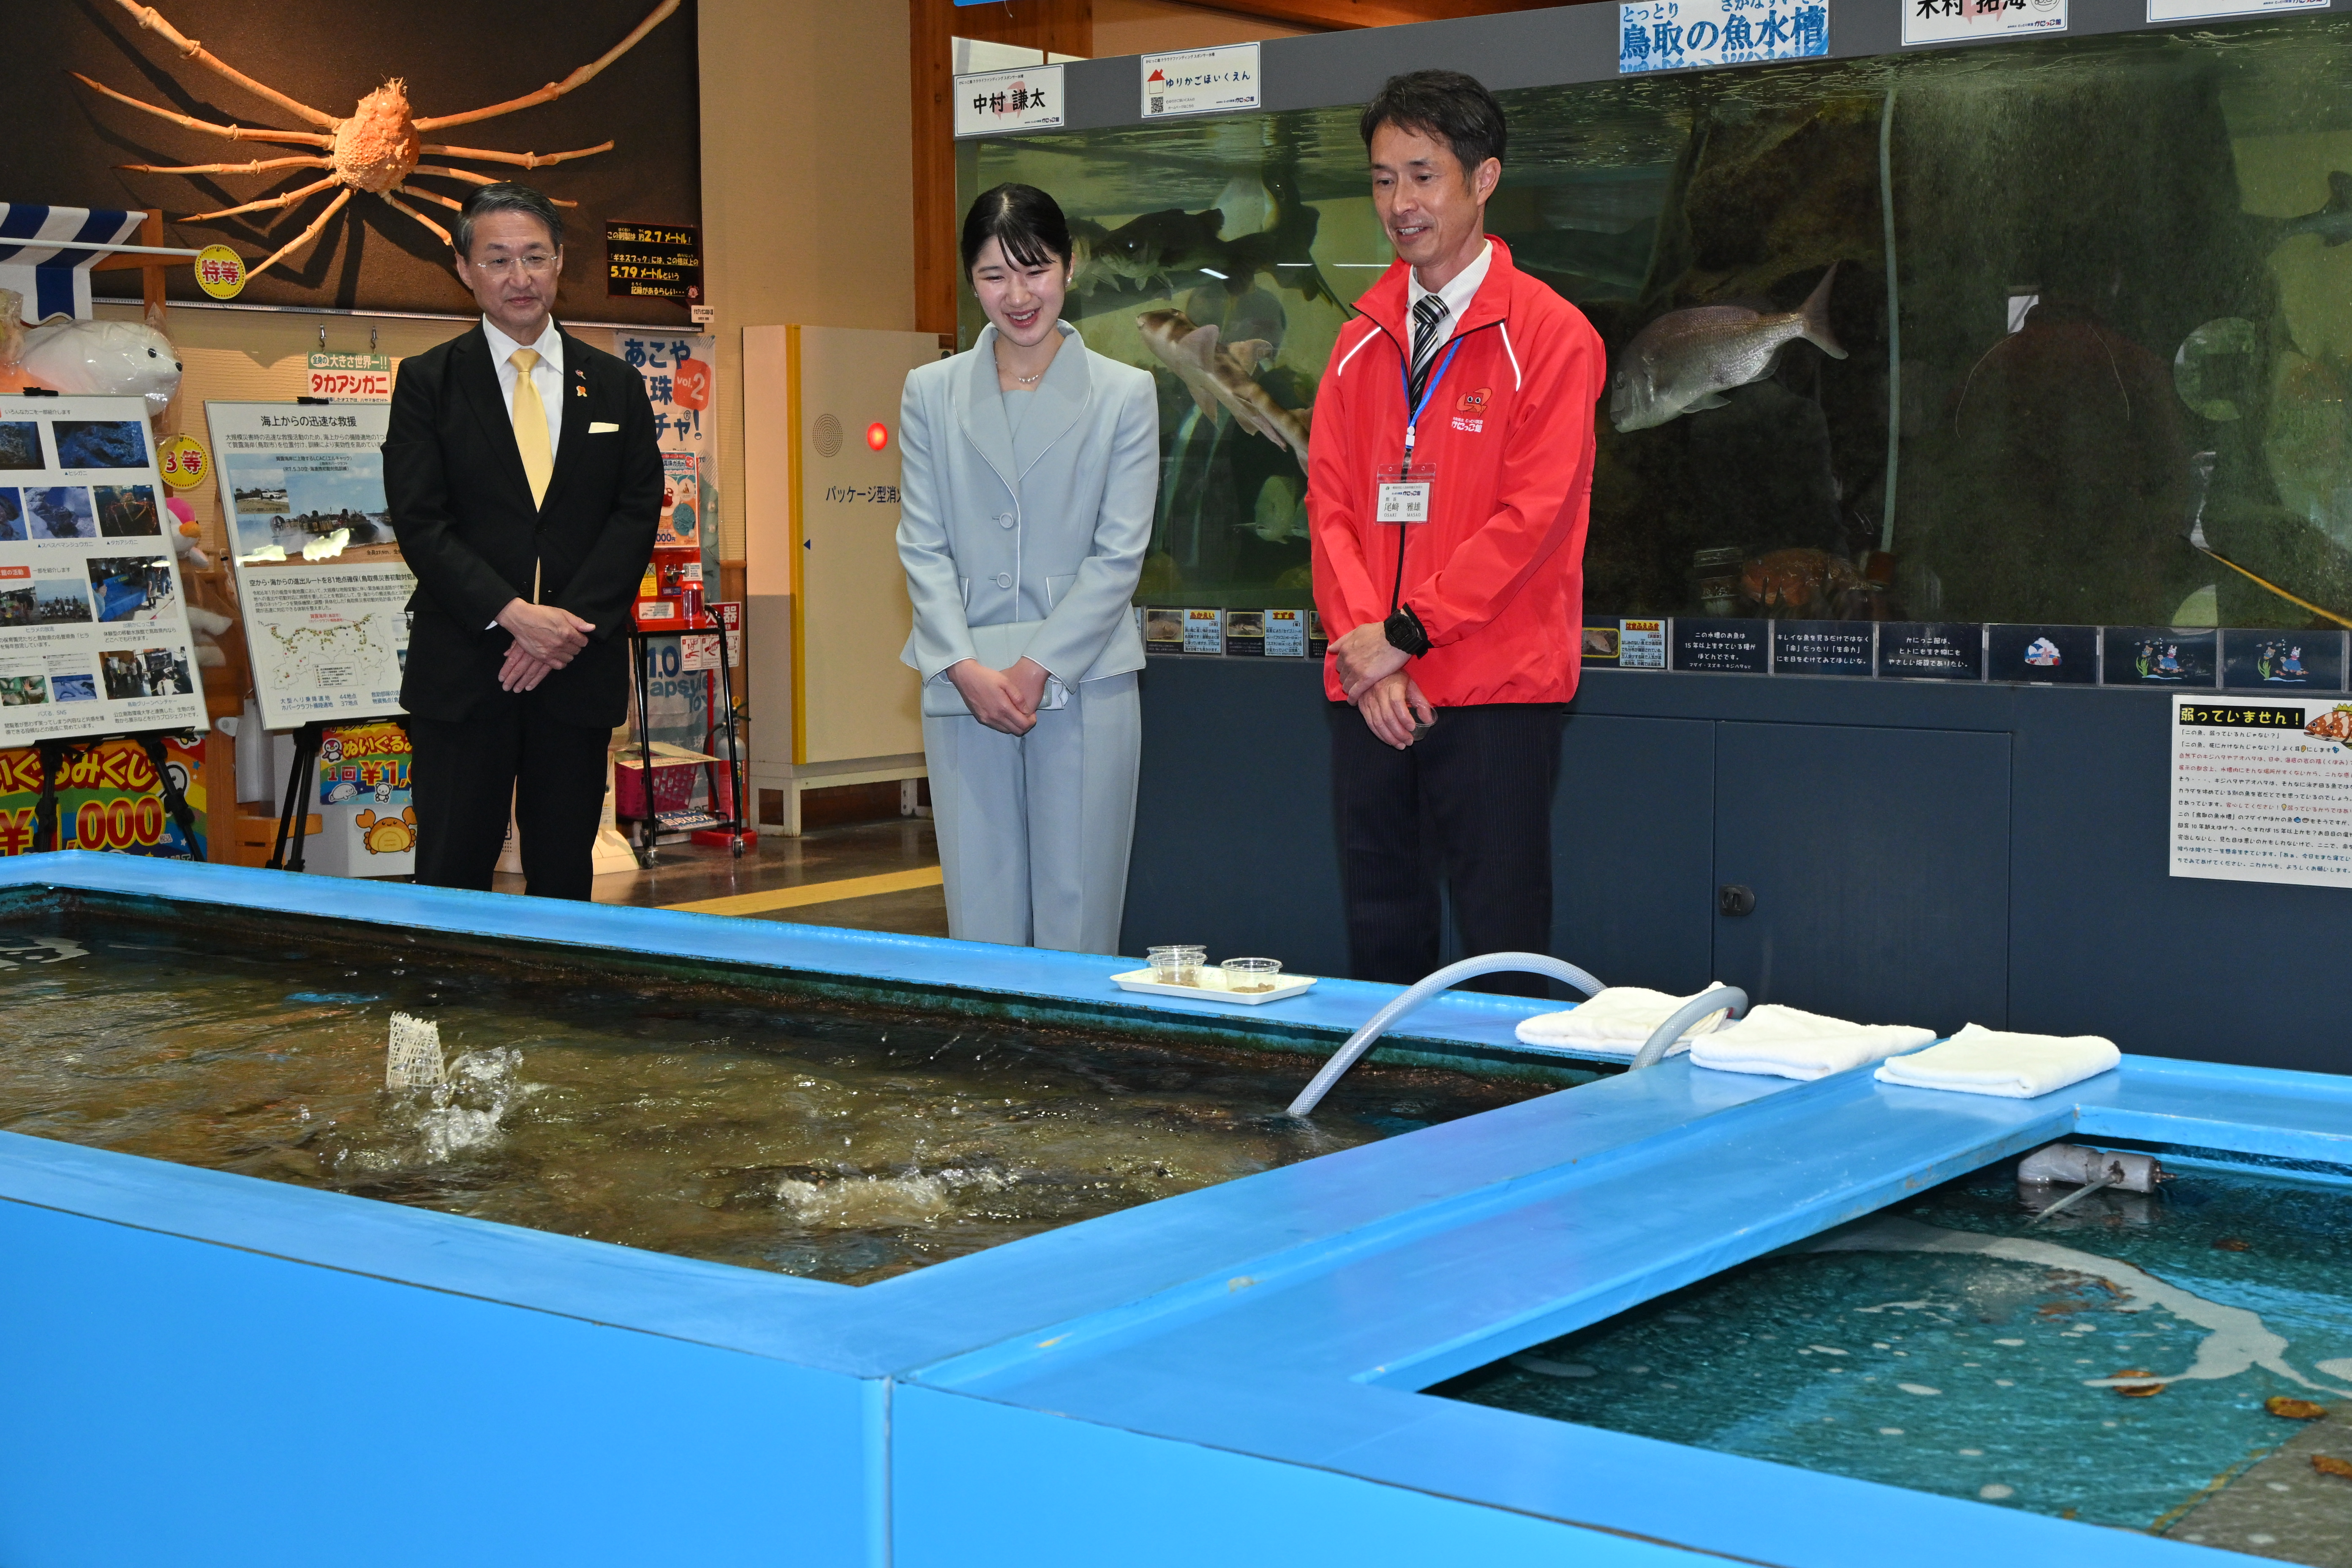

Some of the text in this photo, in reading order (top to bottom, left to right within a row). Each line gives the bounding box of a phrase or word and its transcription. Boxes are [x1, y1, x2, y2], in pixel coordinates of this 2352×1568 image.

[1622, 2, 1679, 22] とっとり
[1619, 5, 1827, 60] 鳥取の魚水槽
[1166, 71, 1250, 88] ゆりかごほいくえん
[973, 88, 1046, 114] 中村 謙太
[638, 230, 662, 242] 約2.7
[201, 259, 240, 286] 特等
[610, 265, 680, 280] 5.79 メートルという
[625, 338, 691, 370] あこや
[313, 356, 327, 365] 全身の
[311, 373, 388, 394] タカアシガニ
[641, 375, 673, 406] 珠
[261, 416, 357, 427] 海上からの迅速な救援
[1451, 421, 1483, 433] かにっこ館
[166, 449, 203, 475] 3等
[1406, 502, 1421, 512] 雅雄
[103, 627, 177, 637] 体験型の移動水族館で鳥取県内なら
[1777, 634, 1869, 642] キレイな魚を見るだけではなく
[1906, 637, 1950, 645] かにっこ館は、
[1786, 644, 1860, 654] 「命」だったり「生命力」
[1899, 648, 1961, 656] ヒトにも生き物にも
[1777, 656, 1866, 664] にも目をむけてみてほしいな。
[1889, 659, 1968, 667] やさしい施設でありたい。
[2180, 708, 2299, 725] 弱っていません！
[2182, 729, 2279, 739] 「この魚、弱っているんじゃない？」
[328, 766, 357, 782] 1回
[2179, 765, 2352, 778] 展示の都合上、水槽内にそんな場所がすくないから、こんな感
